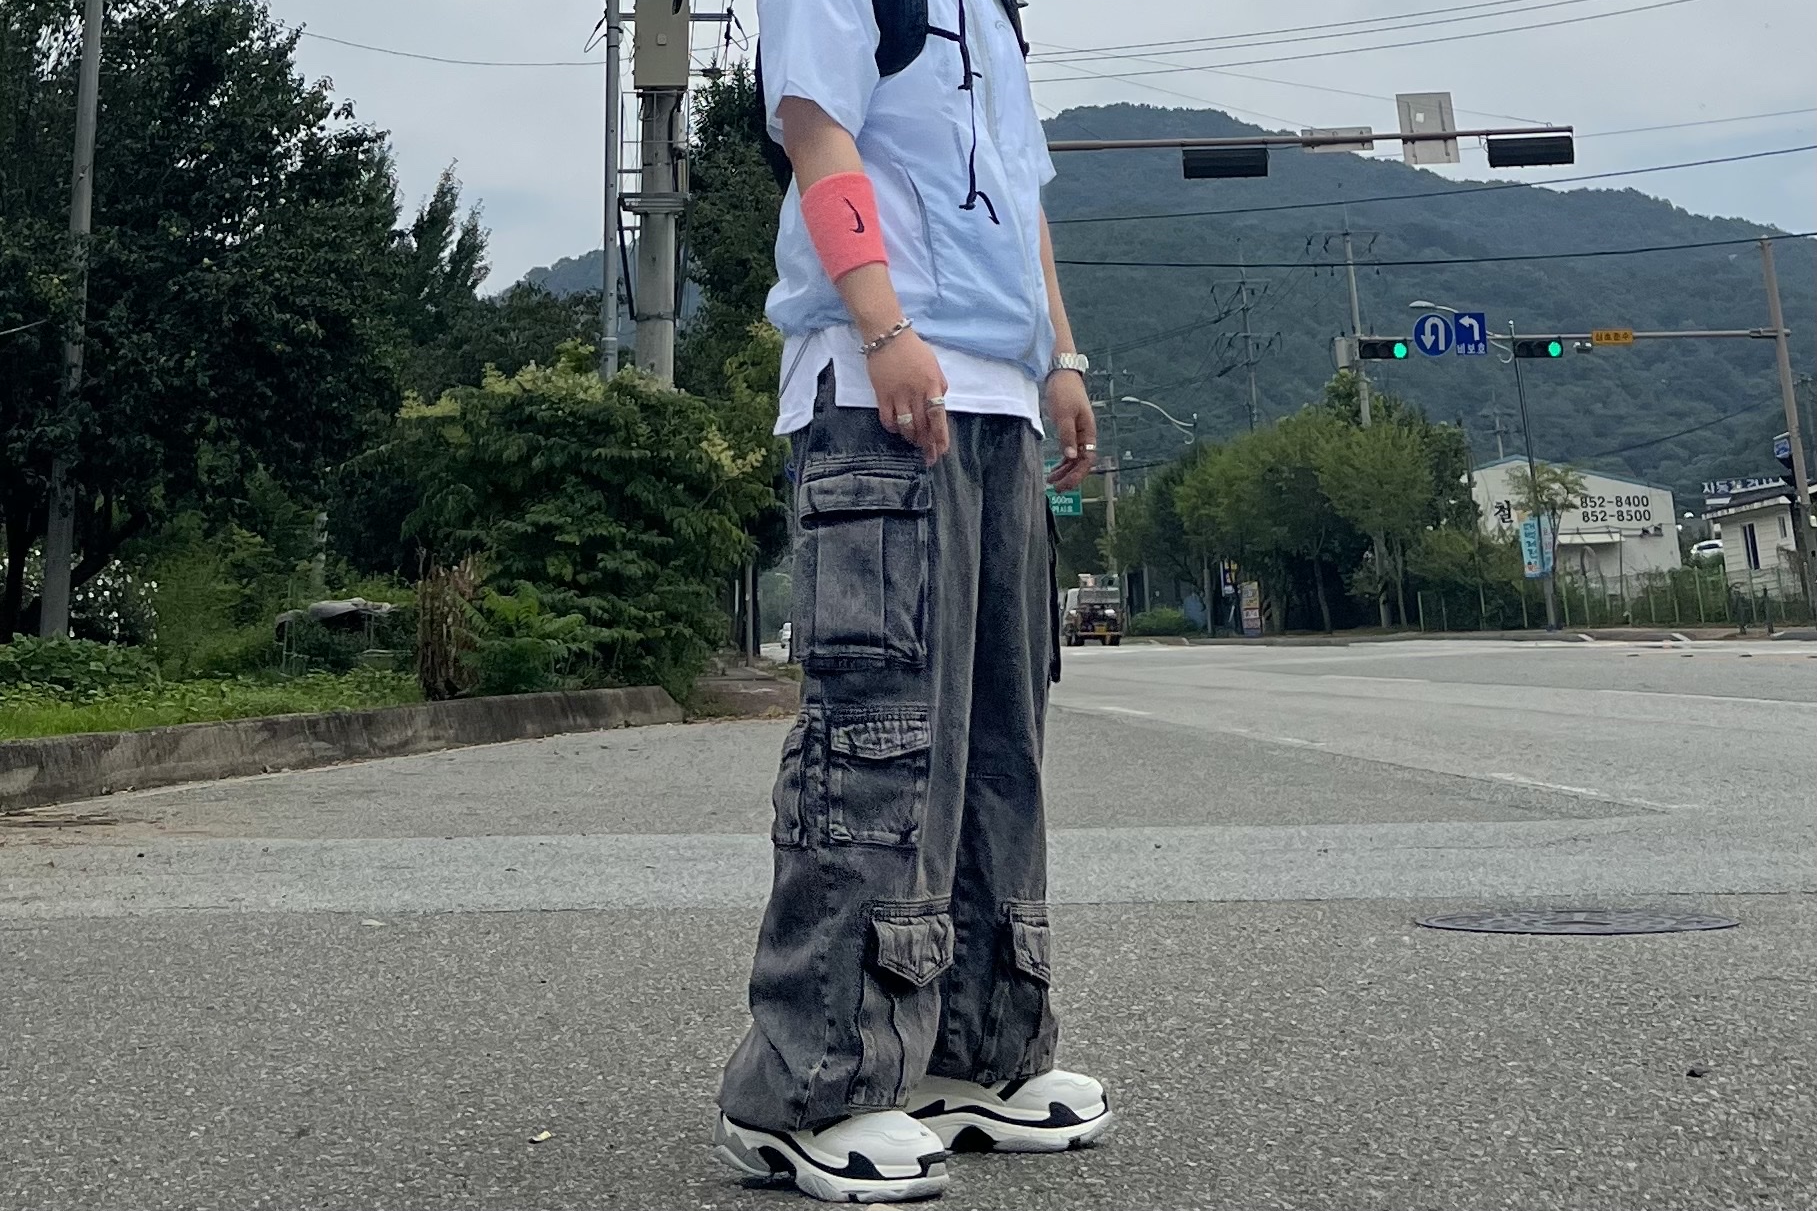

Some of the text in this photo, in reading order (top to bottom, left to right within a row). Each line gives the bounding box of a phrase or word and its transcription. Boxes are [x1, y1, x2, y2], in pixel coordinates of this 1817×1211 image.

[1456, 342, 1486, 355] 비보호
[1580, 495, 1649, 509] 852-8400
[1582, 509, 1651, 523] 852-8500
